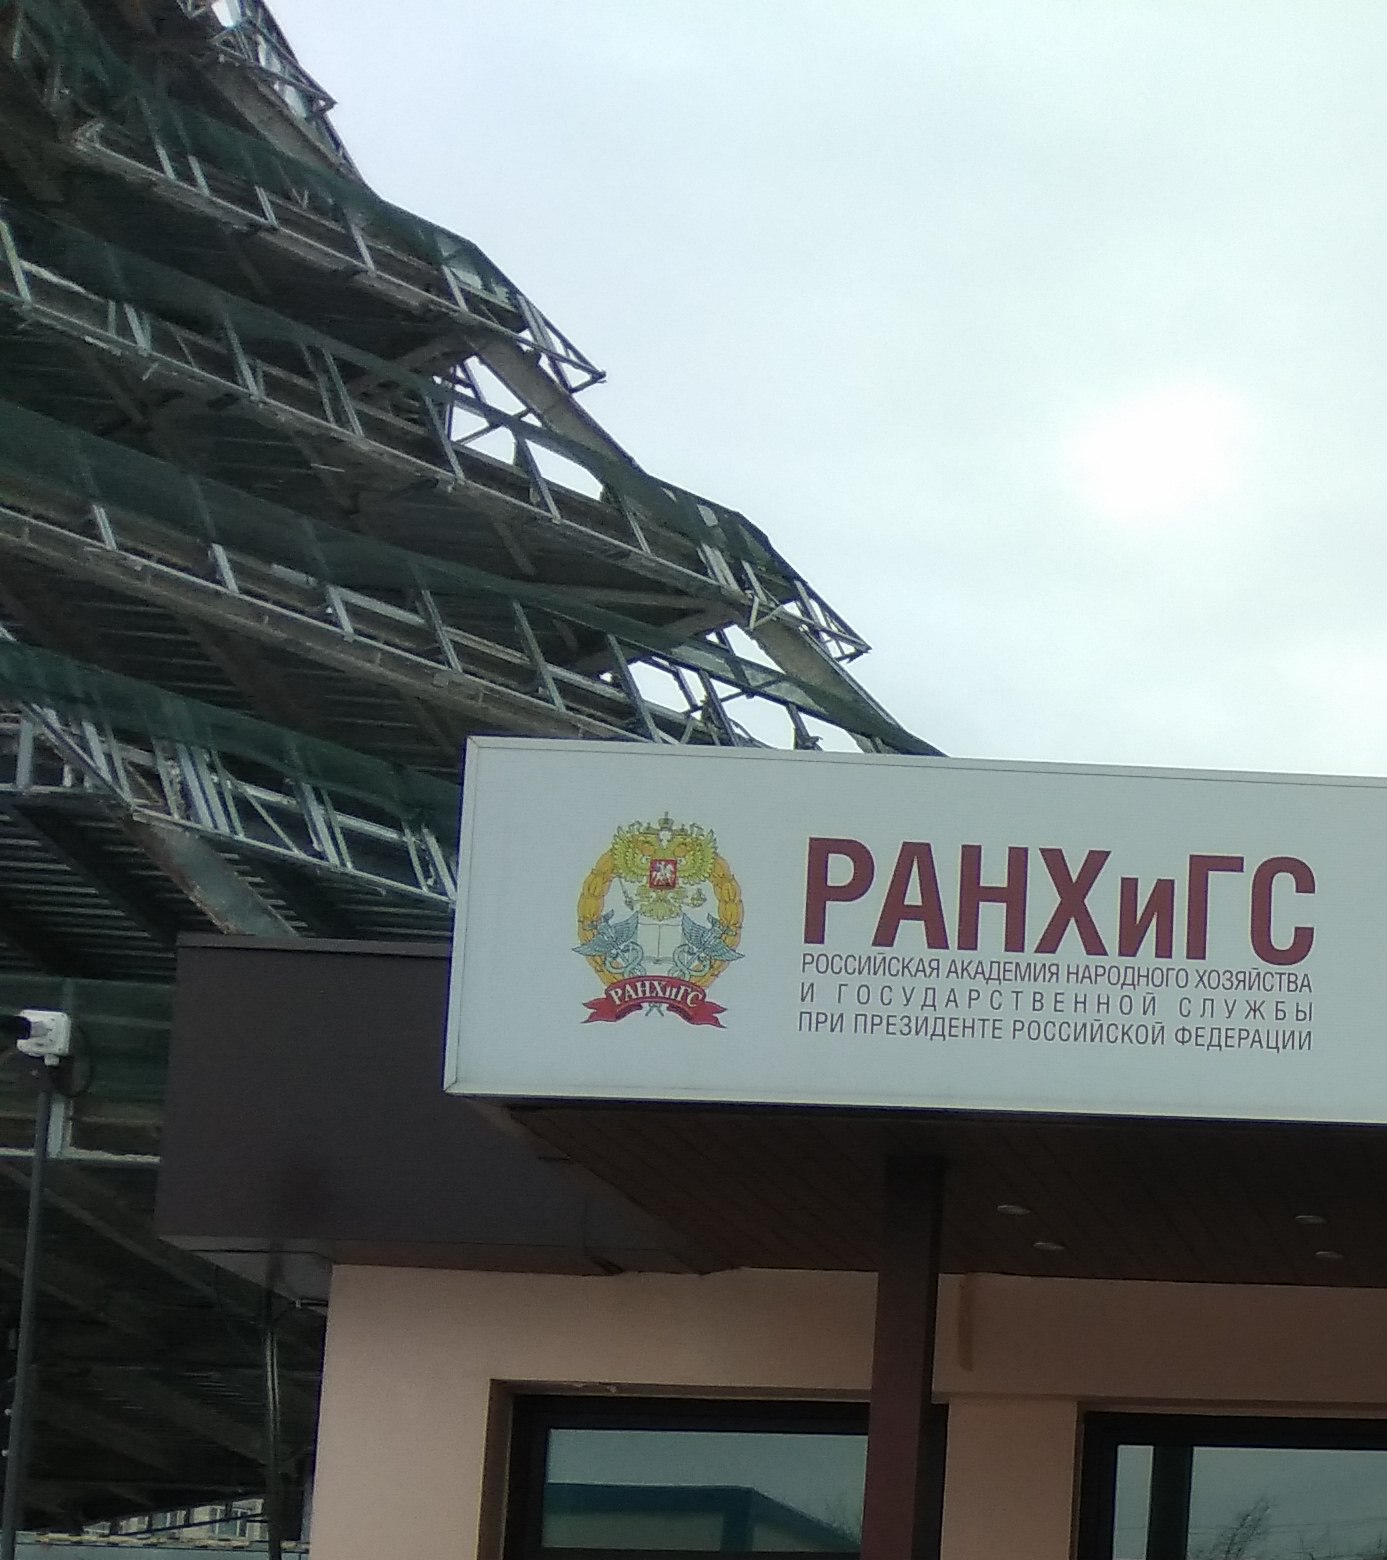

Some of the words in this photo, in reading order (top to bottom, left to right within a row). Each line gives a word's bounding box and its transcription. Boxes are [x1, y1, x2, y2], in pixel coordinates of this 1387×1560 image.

[803, 837, 1316, 967] РАНХиГС
[801, 952, 941, 978] РОССИЙСКАЯ
[946, 958, 1059, 985] АКАДЕМИЯ
[1066, 963, 1189, 990] НАРОДНОГО
[1195, 968, 1313, 993] ХОЗЯЙСТВА
[610, 980, 702, 1008] РАНХиГС
[800, 982, 814, 1003] И
[837, 984, 1156, 1017] ГОСУДАРСТВЕННОЙ
[1179, 996, 1313, 1022] СЛУЖБЫ
[798, 1011, 844, 1033] ПРИ
[854, 1013, 1003, 1041] ПРЕЗИДЕНТЕ
[1012, 1018, 1165, 1046] РОССИЙСКОЙ
[1174, 1026, 1312, 1053] ФЕДЕРАЦИИ
